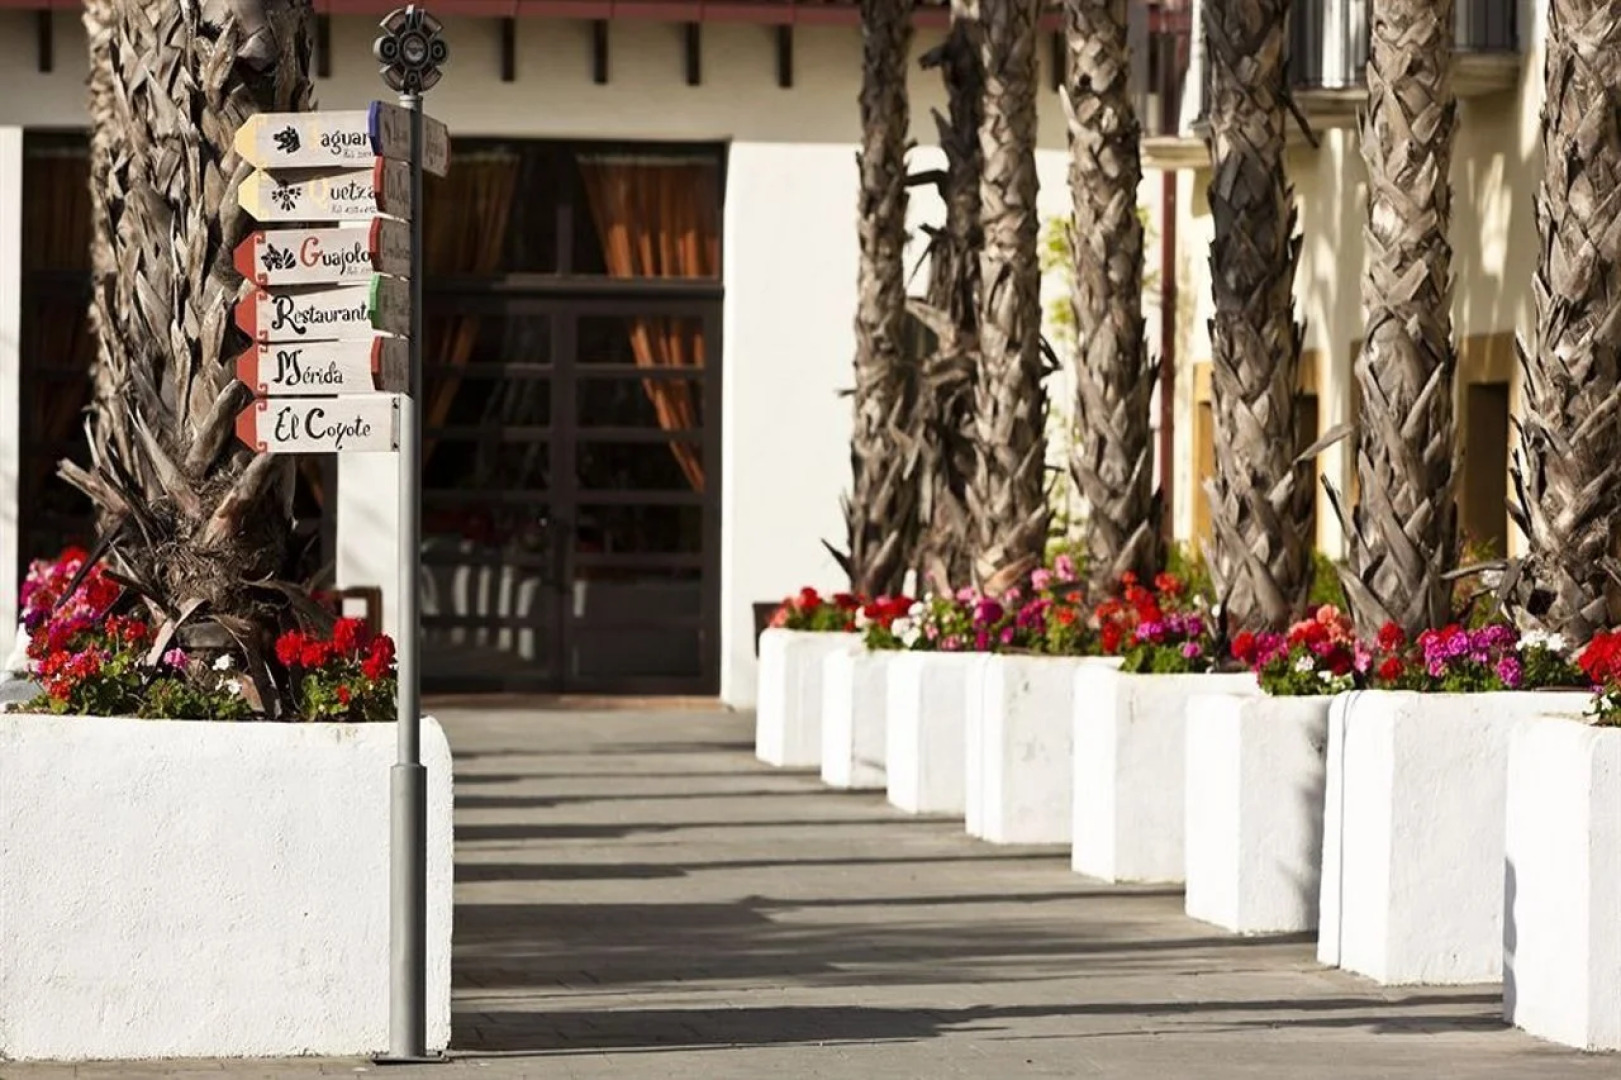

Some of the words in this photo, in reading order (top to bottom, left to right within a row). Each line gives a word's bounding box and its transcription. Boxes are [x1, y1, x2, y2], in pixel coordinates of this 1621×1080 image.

[308, 176, 376, 210] Quetza
[300, 236, 372, 275] Guajolo
[273, 349, 344, 386] Mérida
[274, 406, 300, 442] El
[304, 407, 371, 450] Coyote
